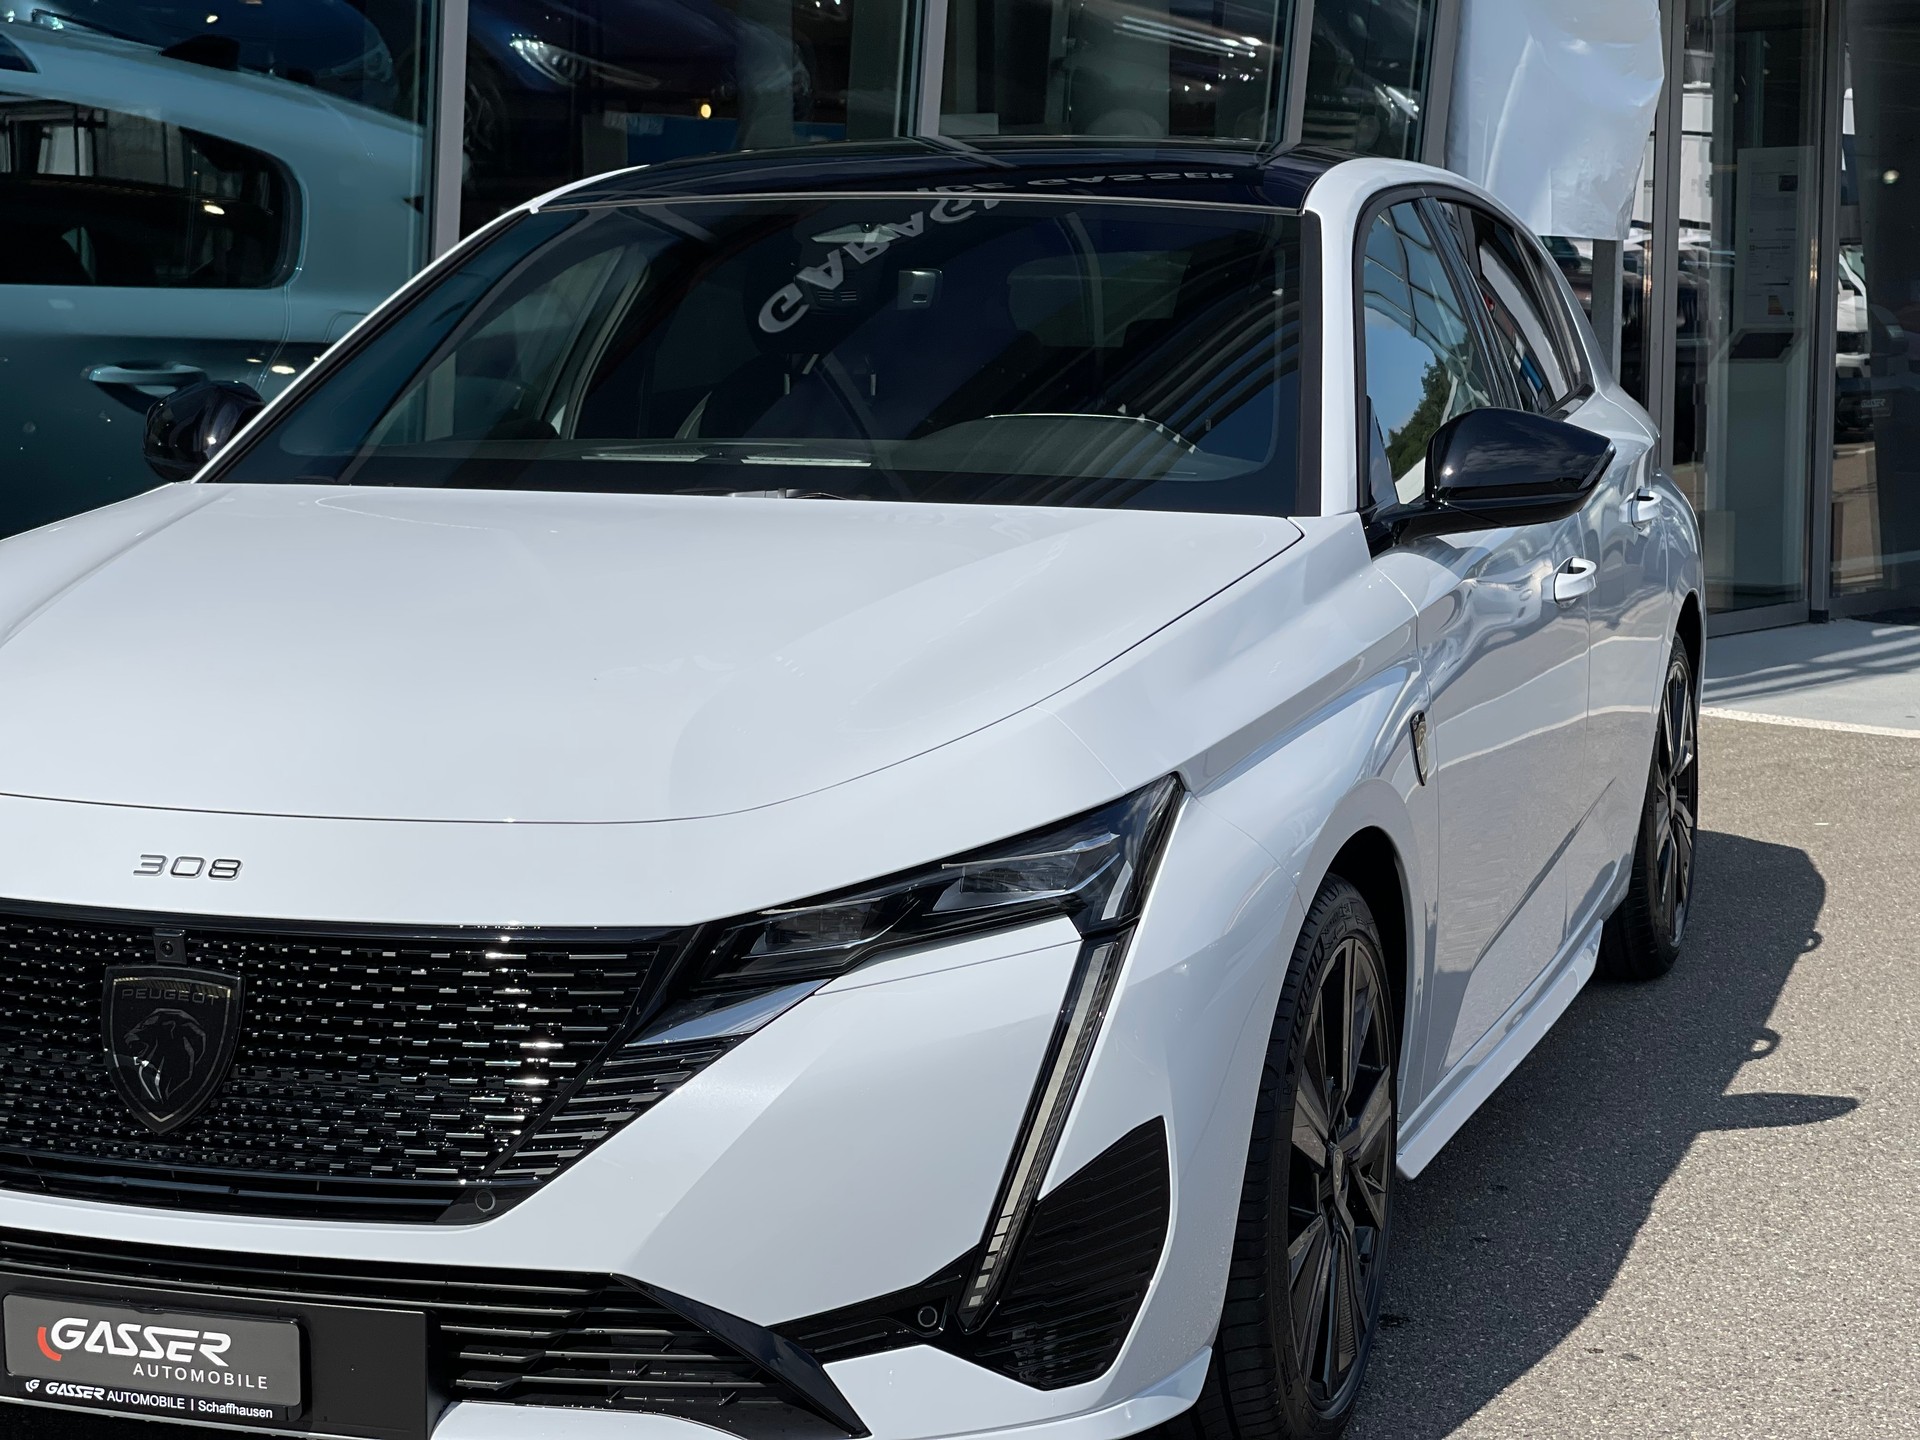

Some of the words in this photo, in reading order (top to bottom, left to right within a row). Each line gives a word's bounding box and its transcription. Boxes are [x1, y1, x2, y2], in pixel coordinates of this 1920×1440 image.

[133, 854, 243, 881] 308
[121, 987, 221, 1006] PEUGEOT
[1287, 940, 1324, 1068] MICHELIN
[50, 1317, 232, 1367] GASSER
[133, 1362, 268, 1390] AUTOMOBILE
[45, 1382, 106, 1401] GASSER
[106, 1390, 186, 1410] AUTOMOBILE
[198, 1399, 273, 1419] Schaffhausen
